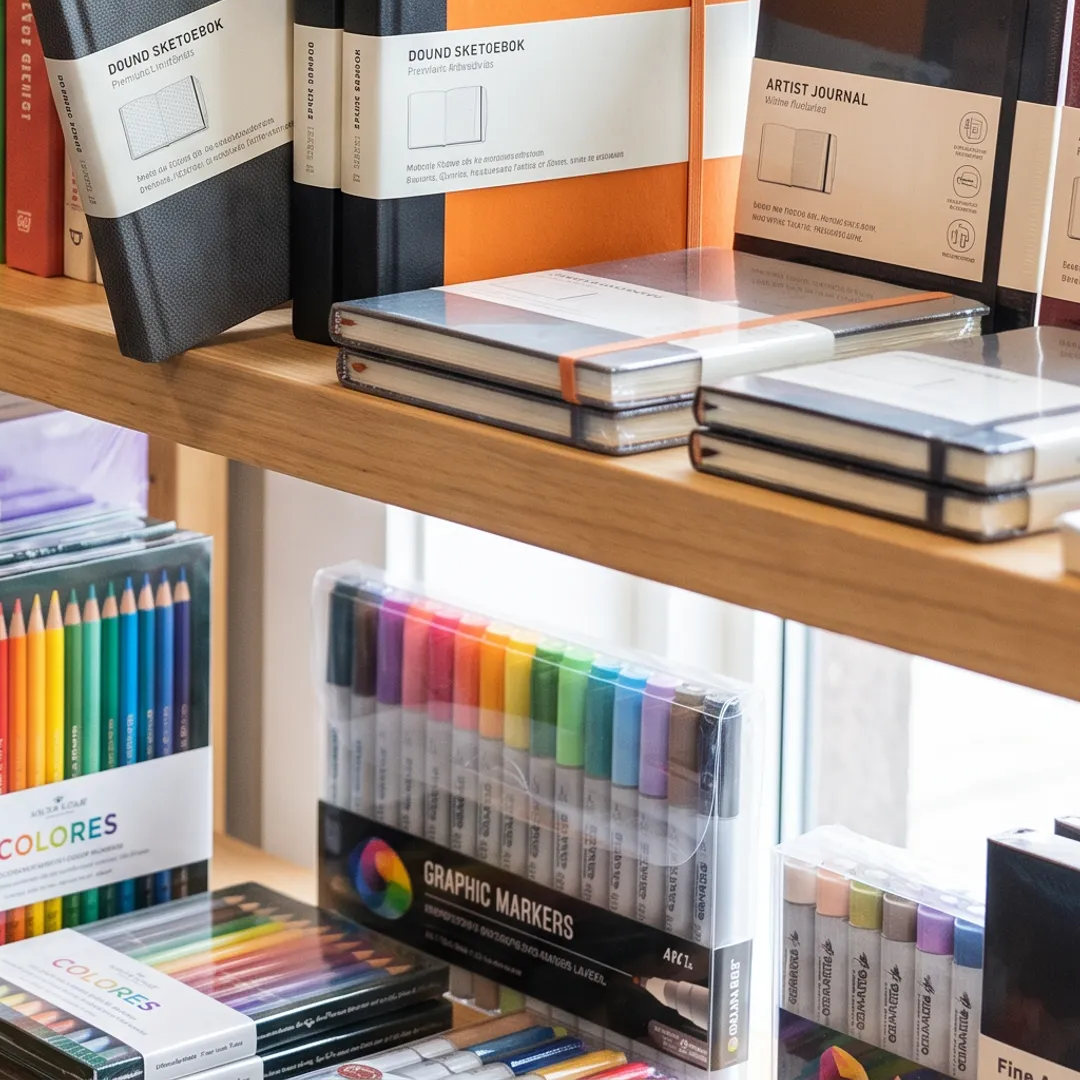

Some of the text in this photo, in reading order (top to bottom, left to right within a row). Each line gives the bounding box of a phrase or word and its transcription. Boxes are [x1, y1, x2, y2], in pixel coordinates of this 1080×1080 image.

[108, 49, 150, 75] DOUND
[152, 18, 224, 57] SKETOEBOK
[408, 39, 525, 62] DOUND SKETOEBOK
[766, 78, 809, 96] ARTIST
[811, 85, 869, 106] JOURNAL
[424, 860, 491, 908] GRAPHIC
[496, 887, 574, 940] MARKERS
[52, 958, 161, 1012] COLORES
